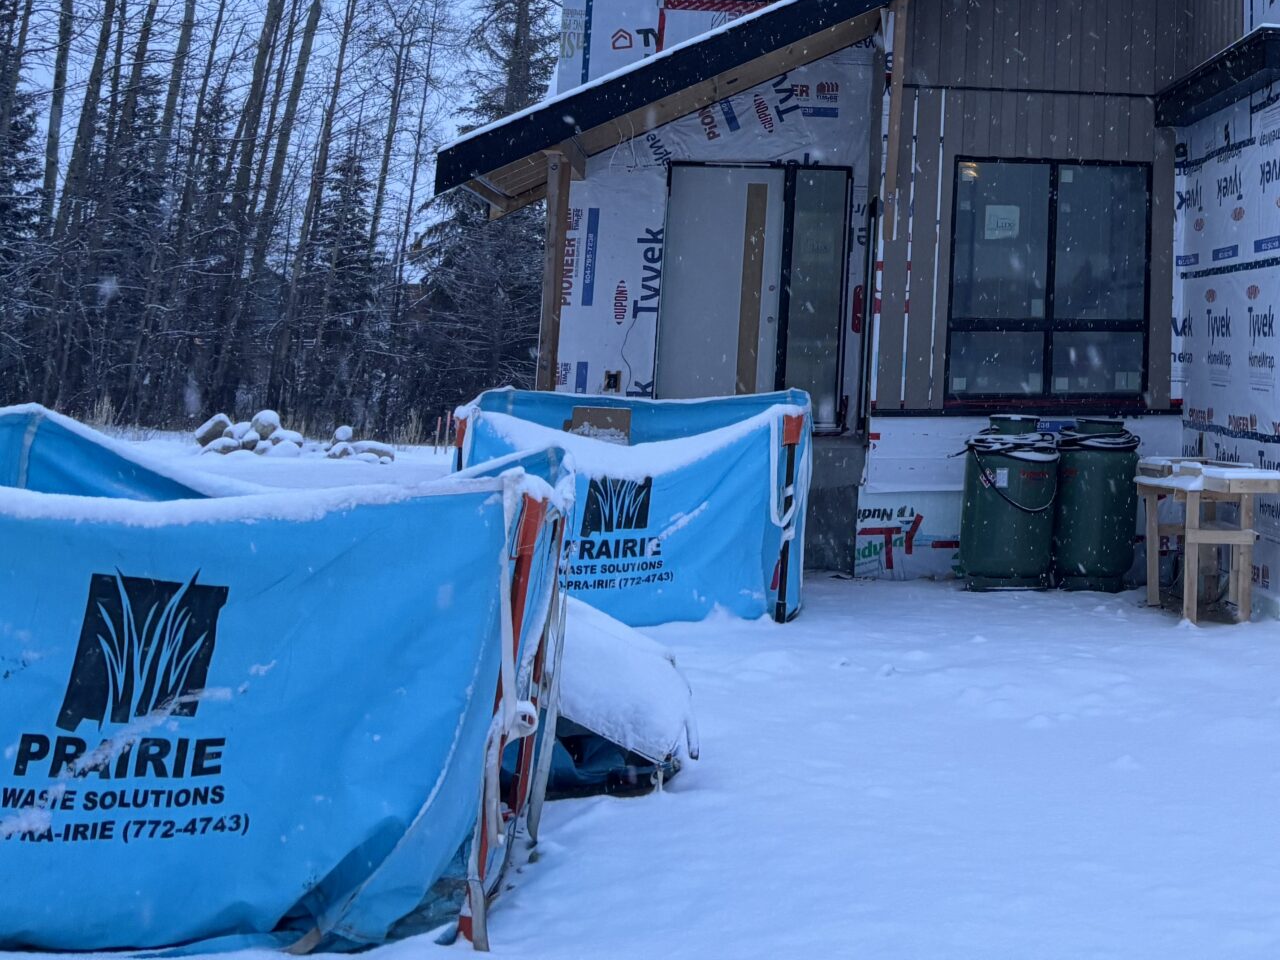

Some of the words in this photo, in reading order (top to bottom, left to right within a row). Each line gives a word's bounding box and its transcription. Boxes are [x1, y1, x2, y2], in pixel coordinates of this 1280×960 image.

[754, 95, 774, 130] DUPONT
[632, 227, 665, 319] Tyvek
[614, 285, 628, 320] DUPONT
[1206, 307, 1232, 346] Tyvek
[1248, 305, 1275, 347] Tyvek
[600, 560, 663, 575] SOLUTIONS
[618, 571, 674, 590] (772-4743)
[83, 785, 225, 811] SOLUTIONS
[122, 813, 250, 844] (772-4743)
